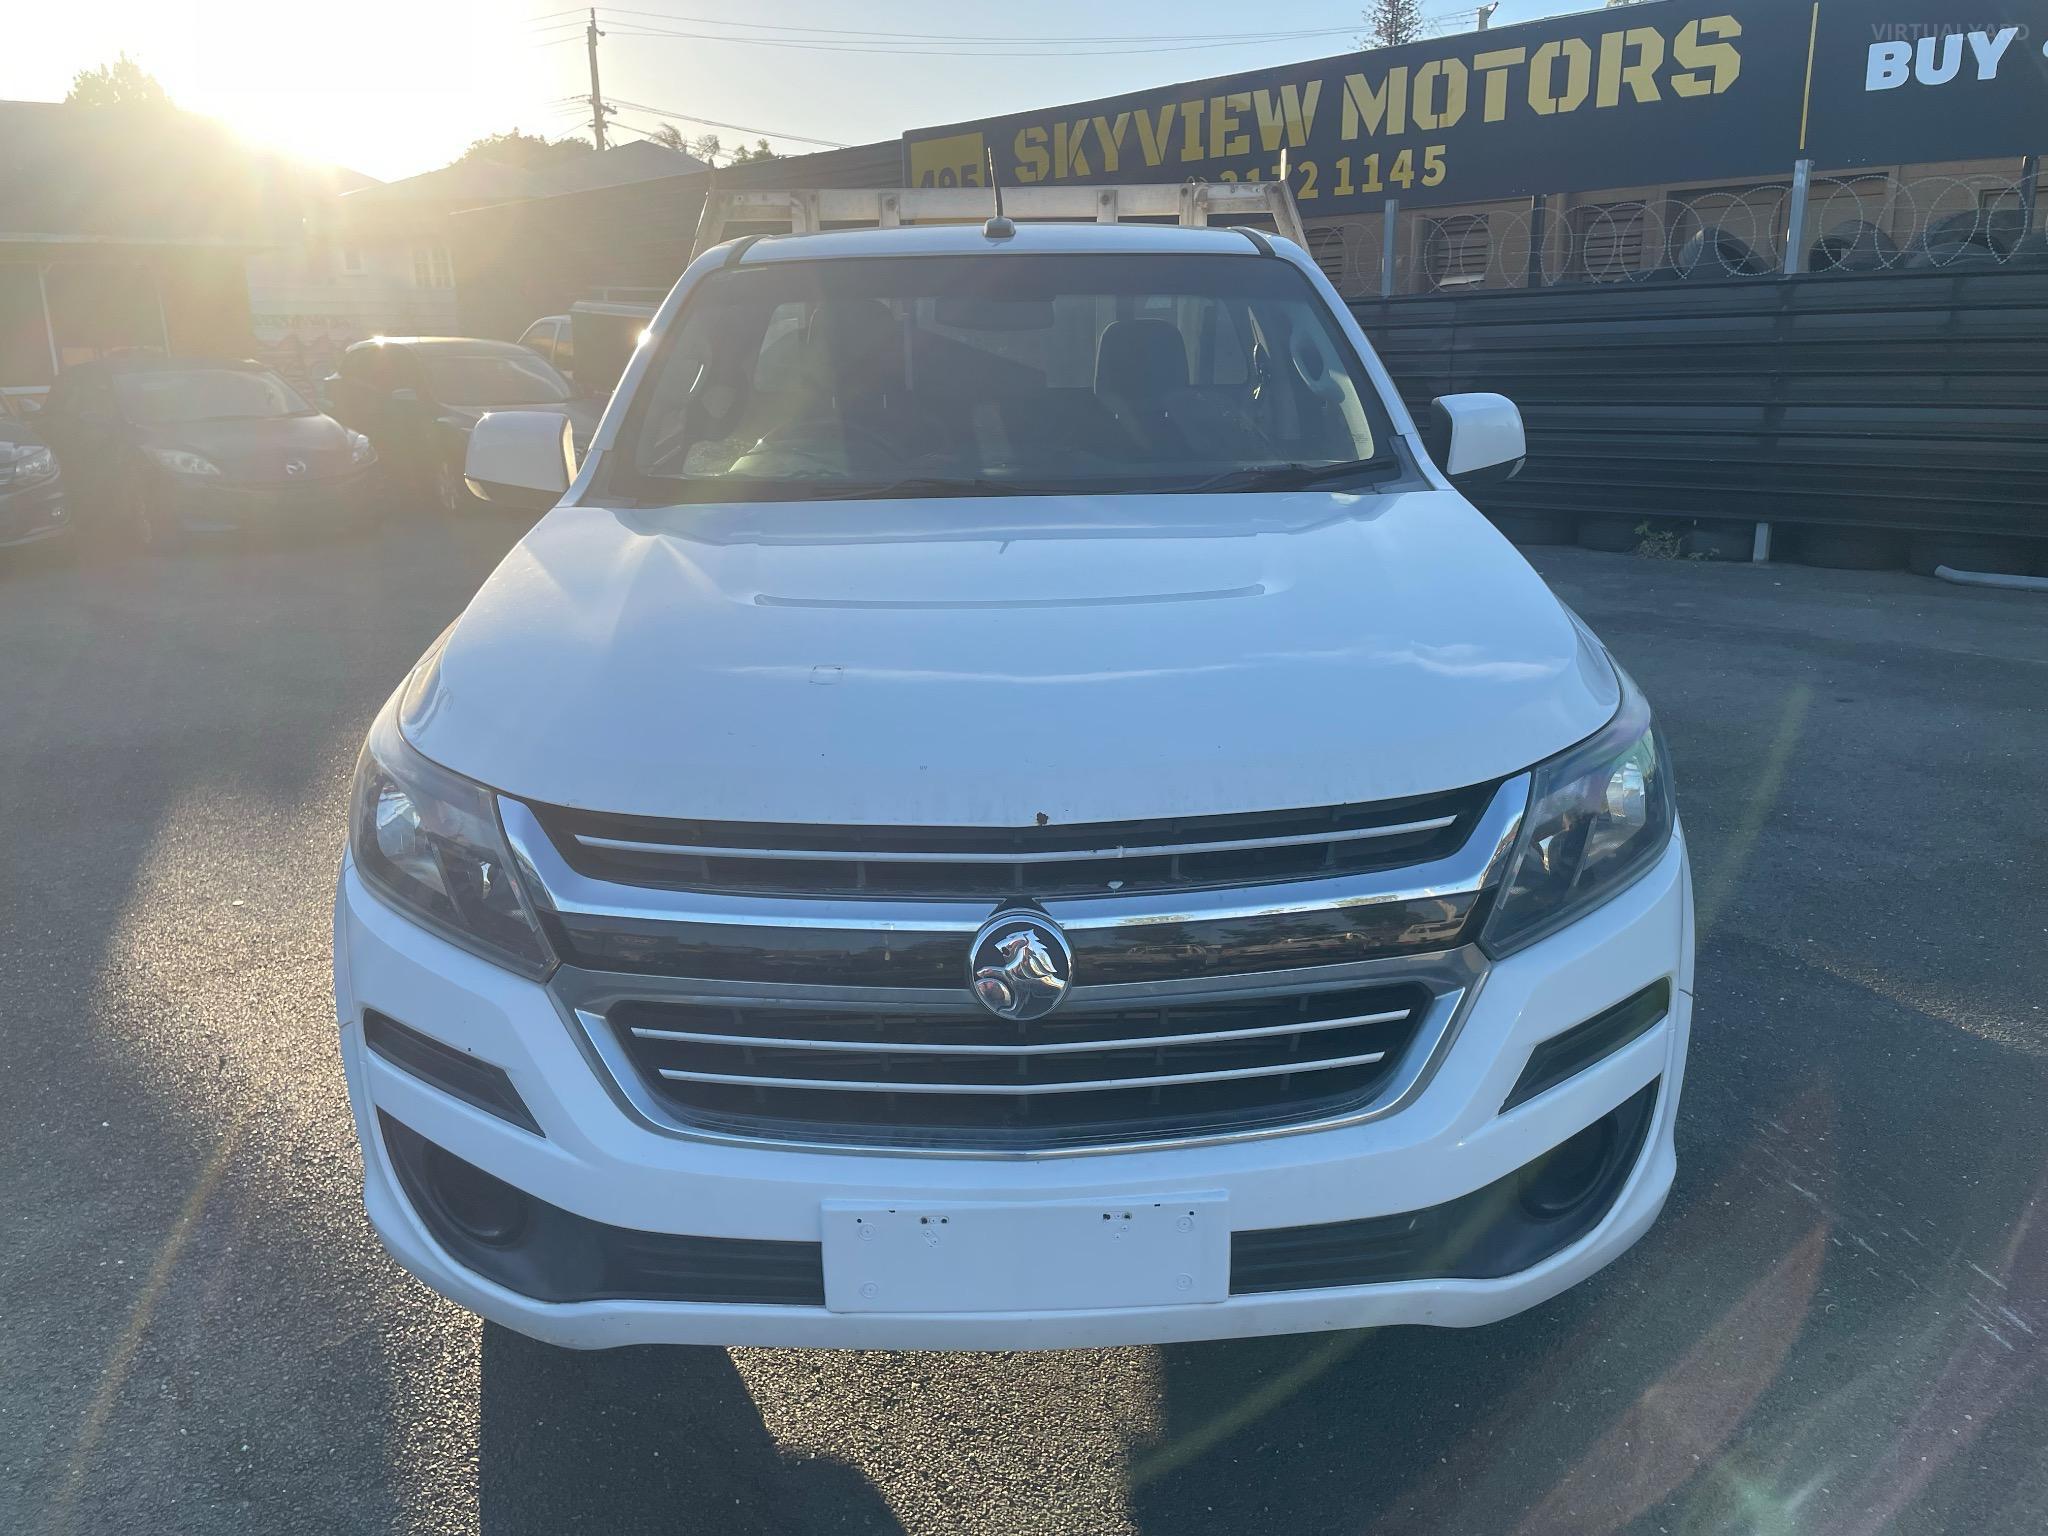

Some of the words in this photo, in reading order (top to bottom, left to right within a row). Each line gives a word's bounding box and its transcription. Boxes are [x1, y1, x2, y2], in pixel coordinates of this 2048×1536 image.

[1865, 27, 2019, 91] BUY
[1014, 80, 1322, 183] SKYVIEW
[1341, 15, 1742, 140] MOTORS
[1334, 145, 1446, 196] 1145
